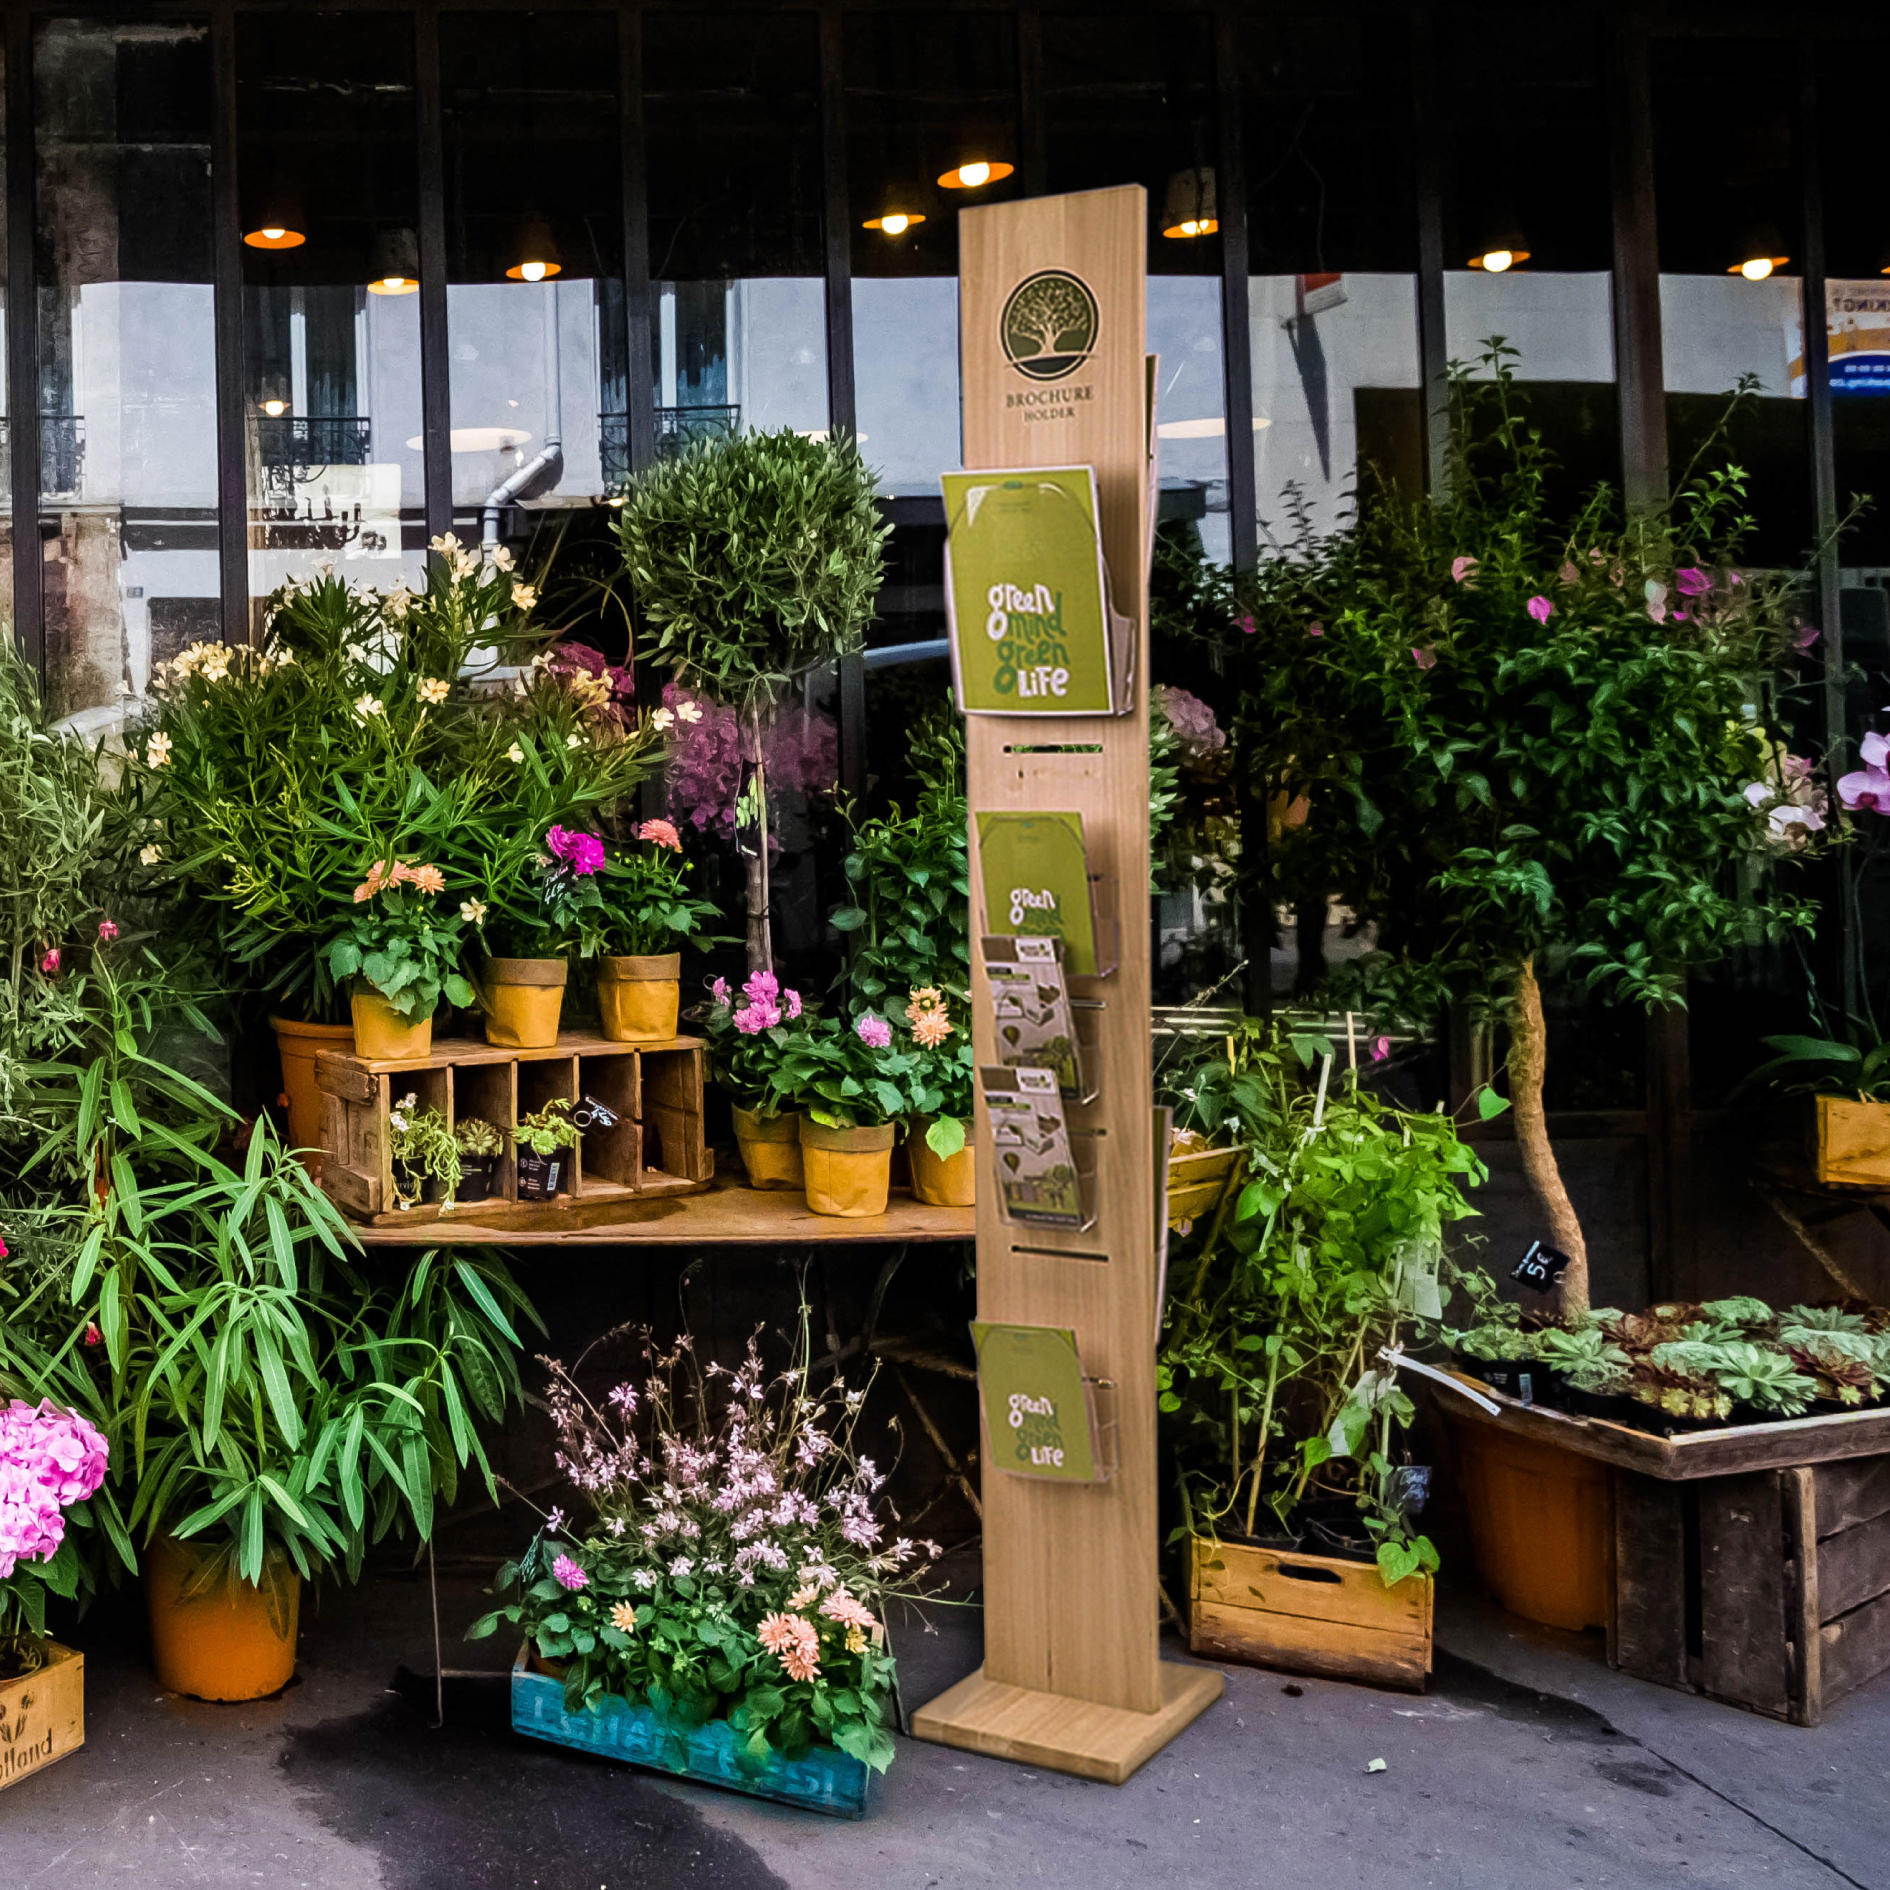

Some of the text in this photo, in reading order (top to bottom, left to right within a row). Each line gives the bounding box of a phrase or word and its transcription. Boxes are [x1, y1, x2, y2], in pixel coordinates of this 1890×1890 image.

[1006, 385, 1094, 408] BROCHURE
[1023, 407, 1075, 422] HOLDER
[986, 583, 1055, 641] green
[1008, 591, 1067, 644] mind
[994, 640, 1070, 694] green
[1010, 888, 1056, 925] green
[1008, 1394, 1054, 1427] green
